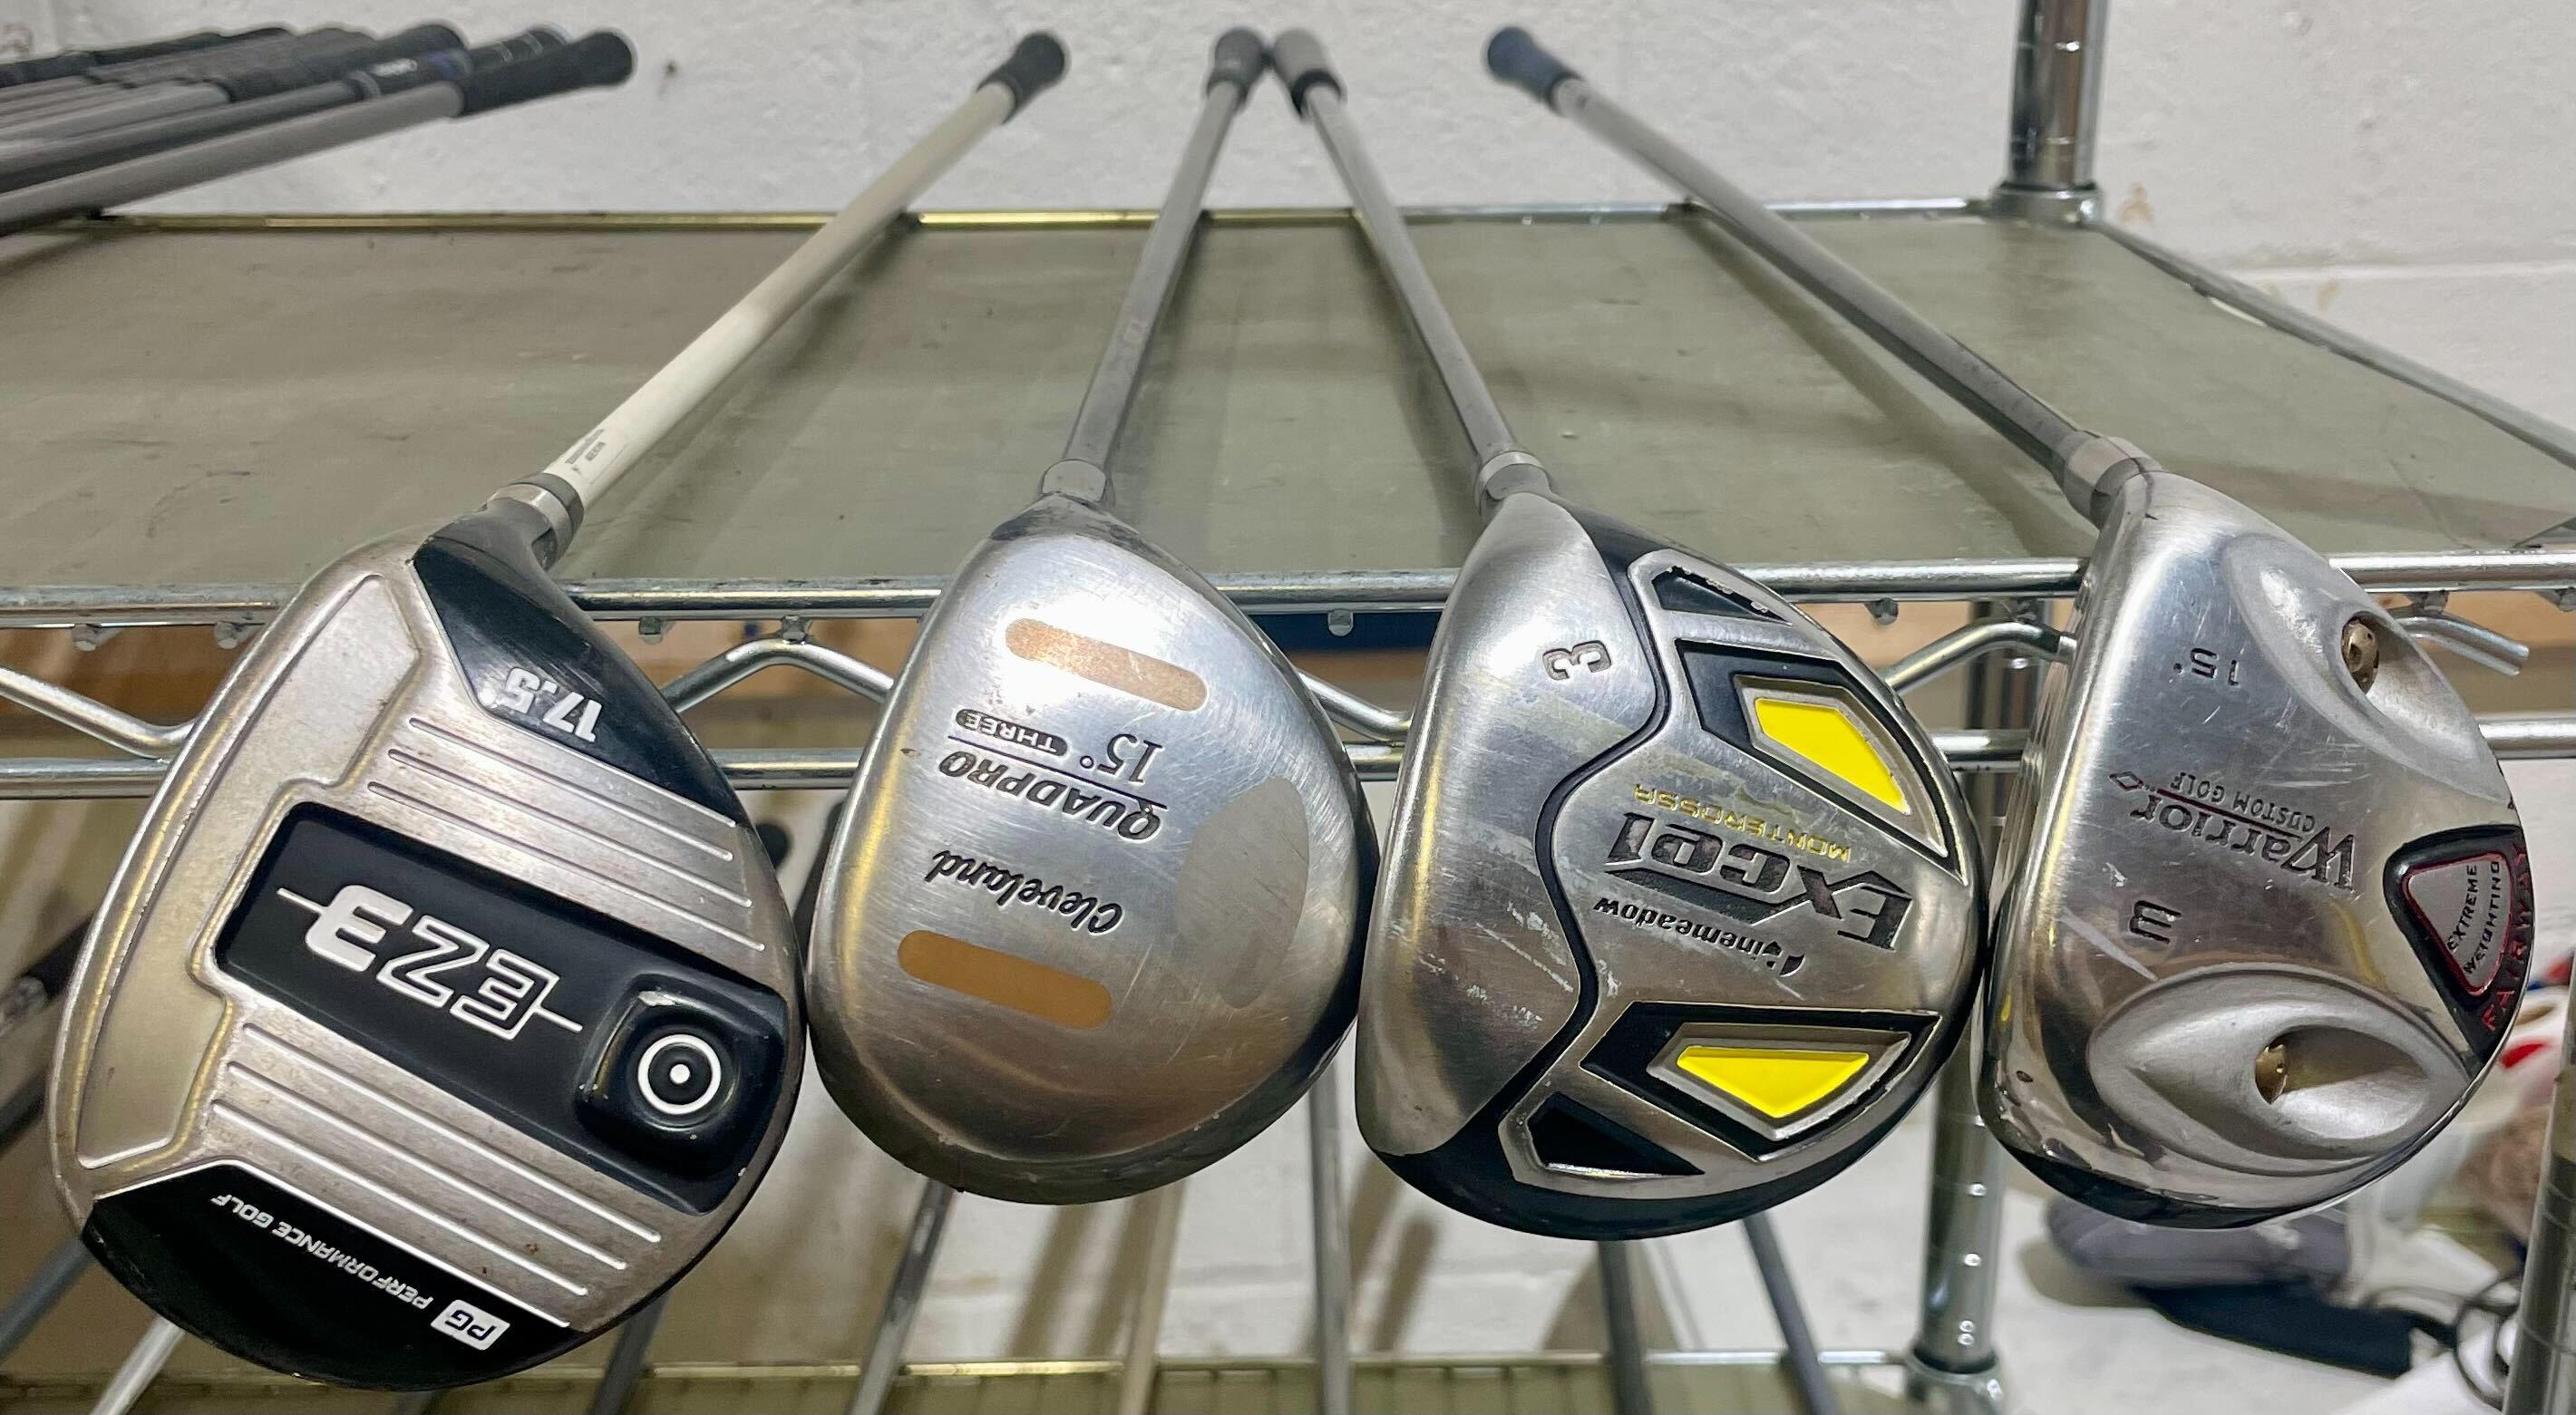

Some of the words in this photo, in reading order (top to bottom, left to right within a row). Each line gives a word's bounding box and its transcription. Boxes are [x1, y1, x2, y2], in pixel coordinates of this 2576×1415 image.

[1542, 639, 1612, 681] 3
[502, 666, 600, 743] 17.5
[961, 712, 1057, 754] THREE
[939, 750, 1163, 842] QUADPRO
[1634, 783, 1852, 862] MONTEROSSA
[2169, 770, 2225, 803] GOLF
[2234, 791, 2316, 834] CUSTOM
[2130, 792, 2357, 892] Warrior
[924, 849, 1125, 935] Cleveland
[2128, 898, 2182, 945] 3
[2447, 864, 2478, 952] EXTREME
[2463, 860, 2502, 974] WEIGHTING
[306, 885, 559, 1041] EZ3
[209, 1193, 275, 1229] GOLF
[271, 1220, 434, 1310] PERFORMANCE
